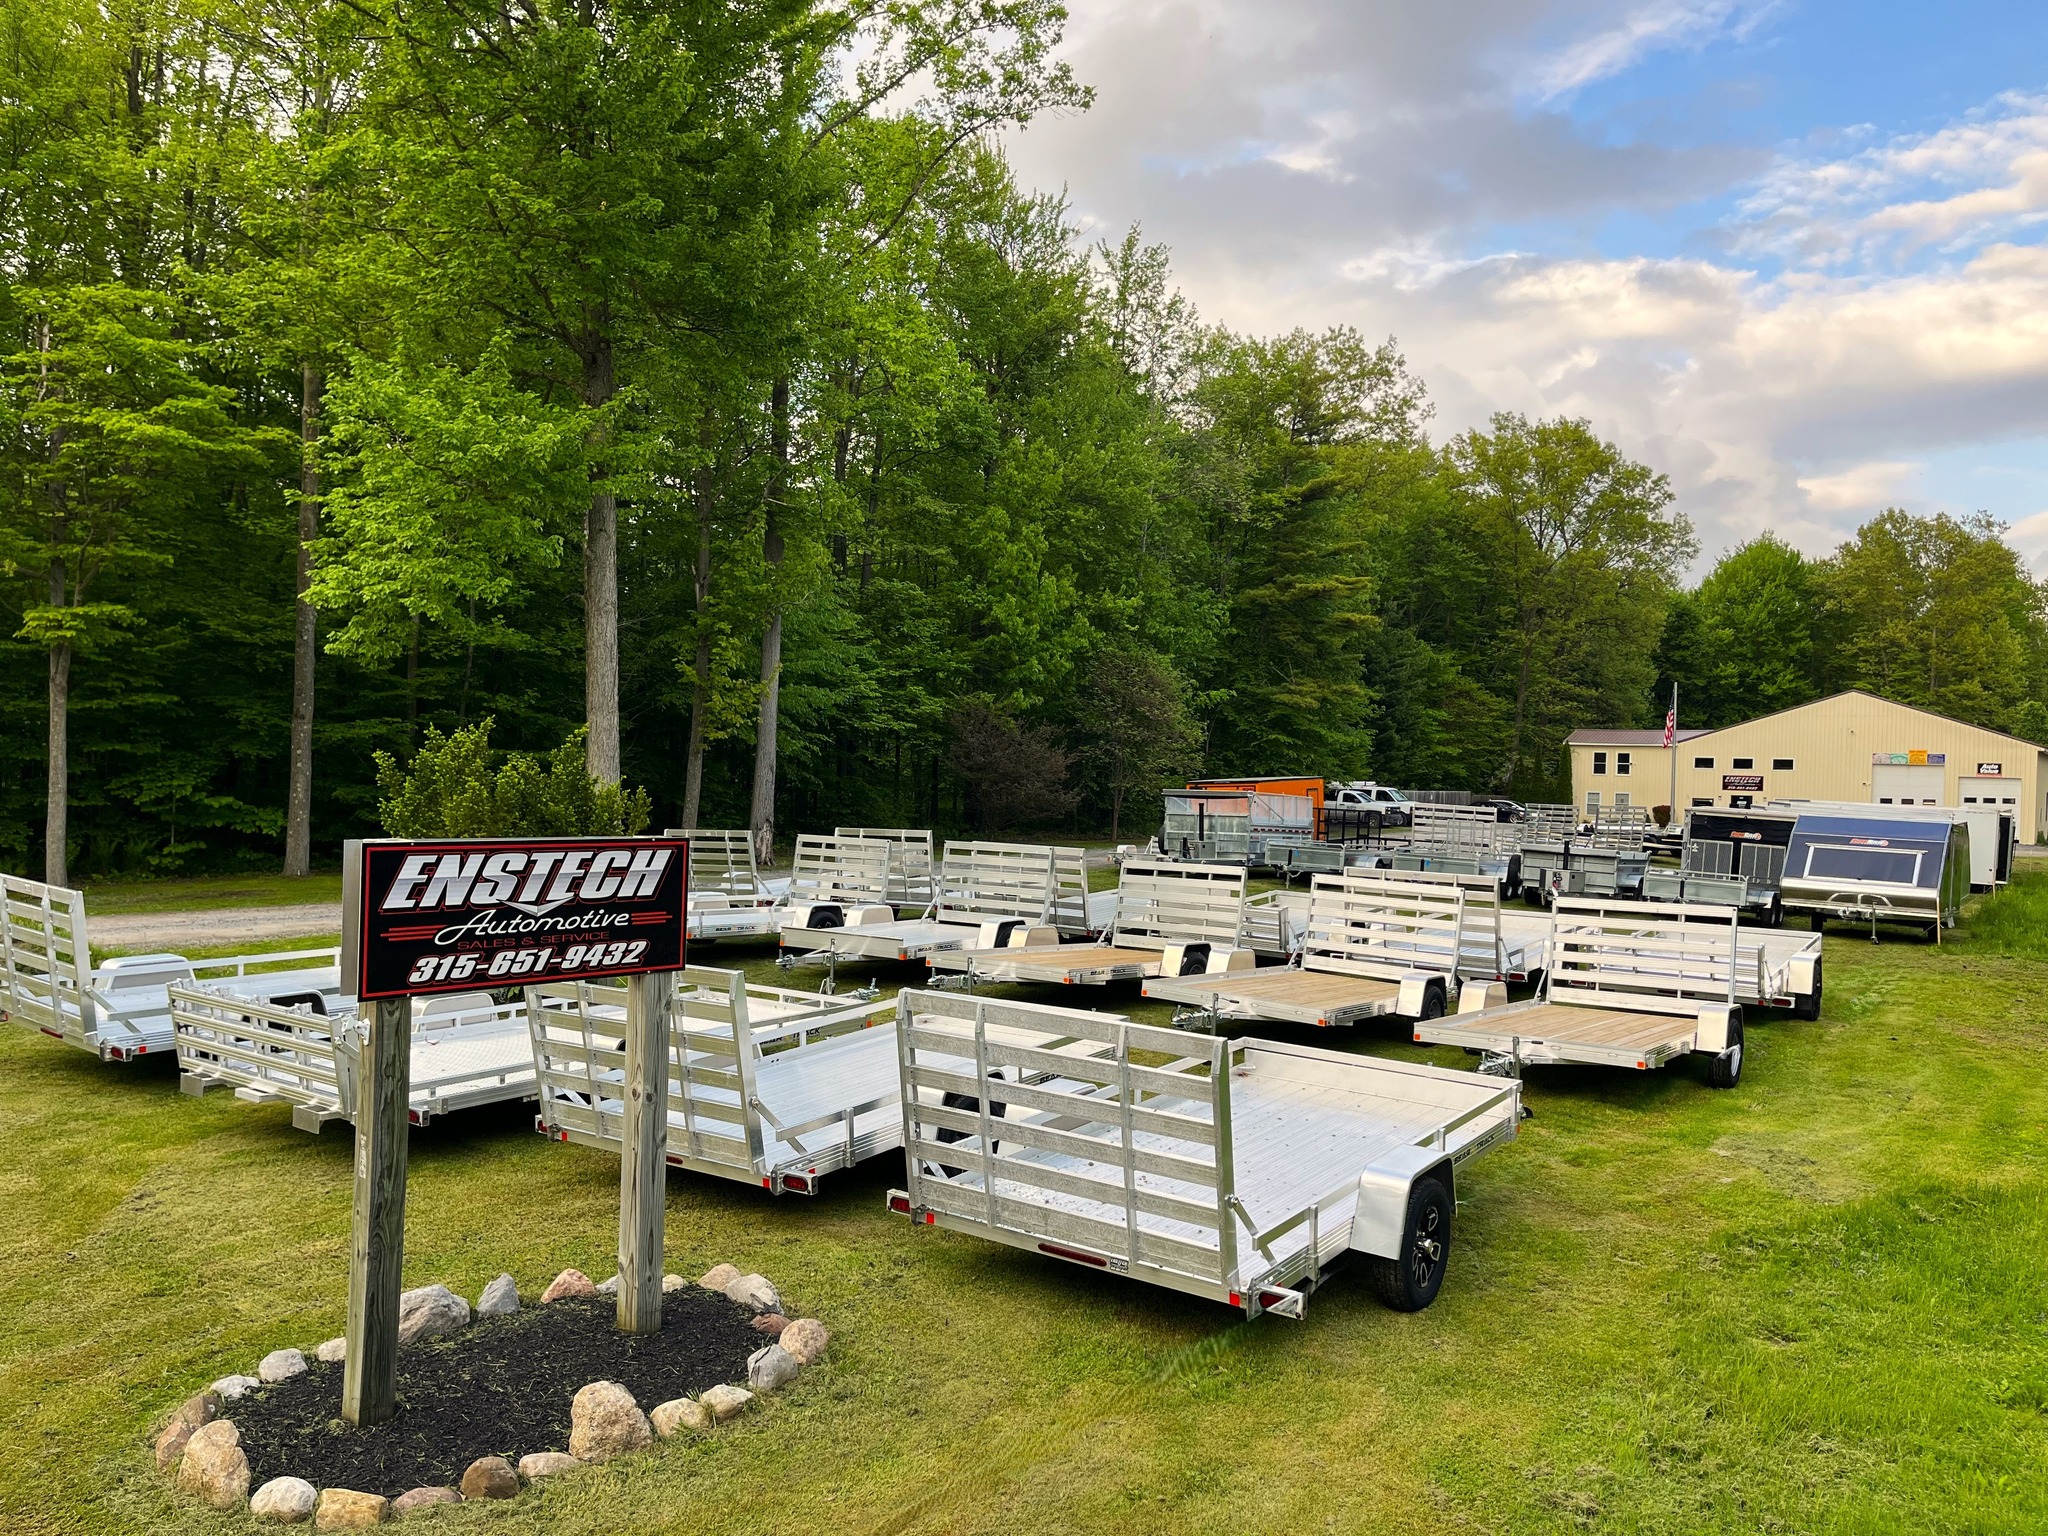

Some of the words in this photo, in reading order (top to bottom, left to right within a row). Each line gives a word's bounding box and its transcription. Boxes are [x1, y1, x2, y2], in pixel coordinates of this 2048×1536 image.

[381, 849, 673, 909] ENSTECH
[434, 909, 630, 946] Automotive
[457, 936, 516, 950] SALES
[521, 935, 536, 946] &
[540, 930, 611, 944] SERVICE
[408, 940, 649, 984] 315-651-9432
